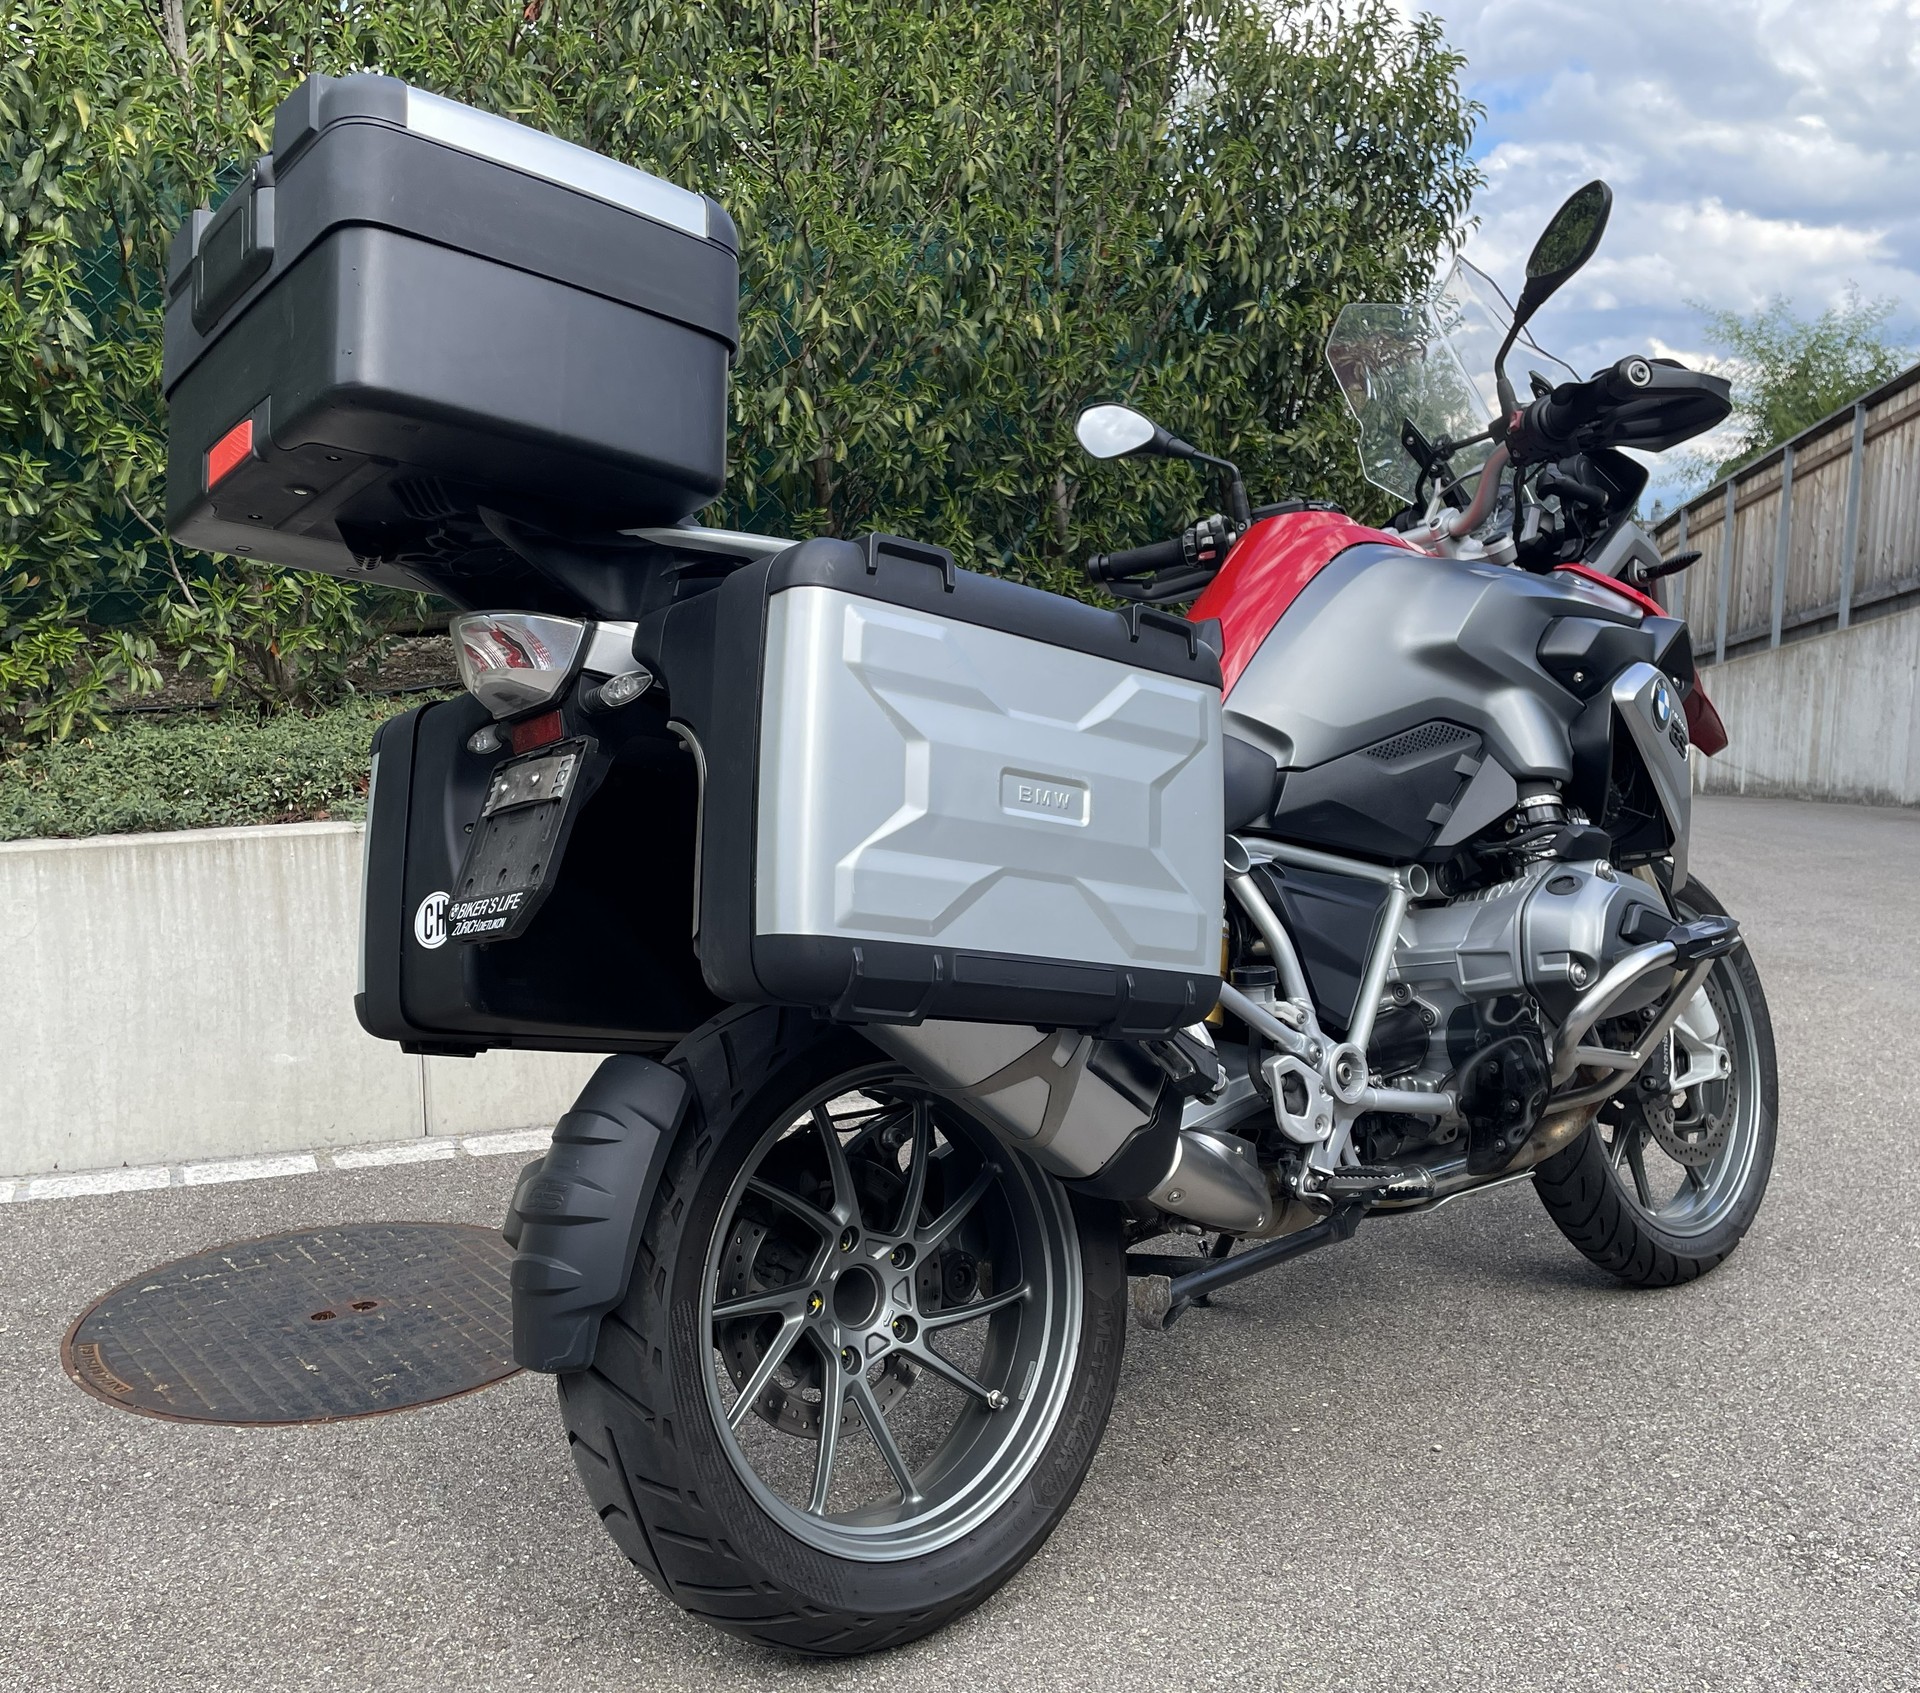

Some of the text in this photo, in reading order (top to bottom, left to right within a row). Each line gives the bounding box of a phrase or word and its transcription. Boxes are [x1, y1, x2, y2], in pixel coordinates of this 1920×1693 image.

[1018, 785, 1071, 810] BMW
[424, 900, 447, 940] CH
[457, 892, 524, 920] BIKER'S LIFE
[451, 919, 482, 936] ZÜRICH
[1055, 1308, 1114, 1473] METZELER
